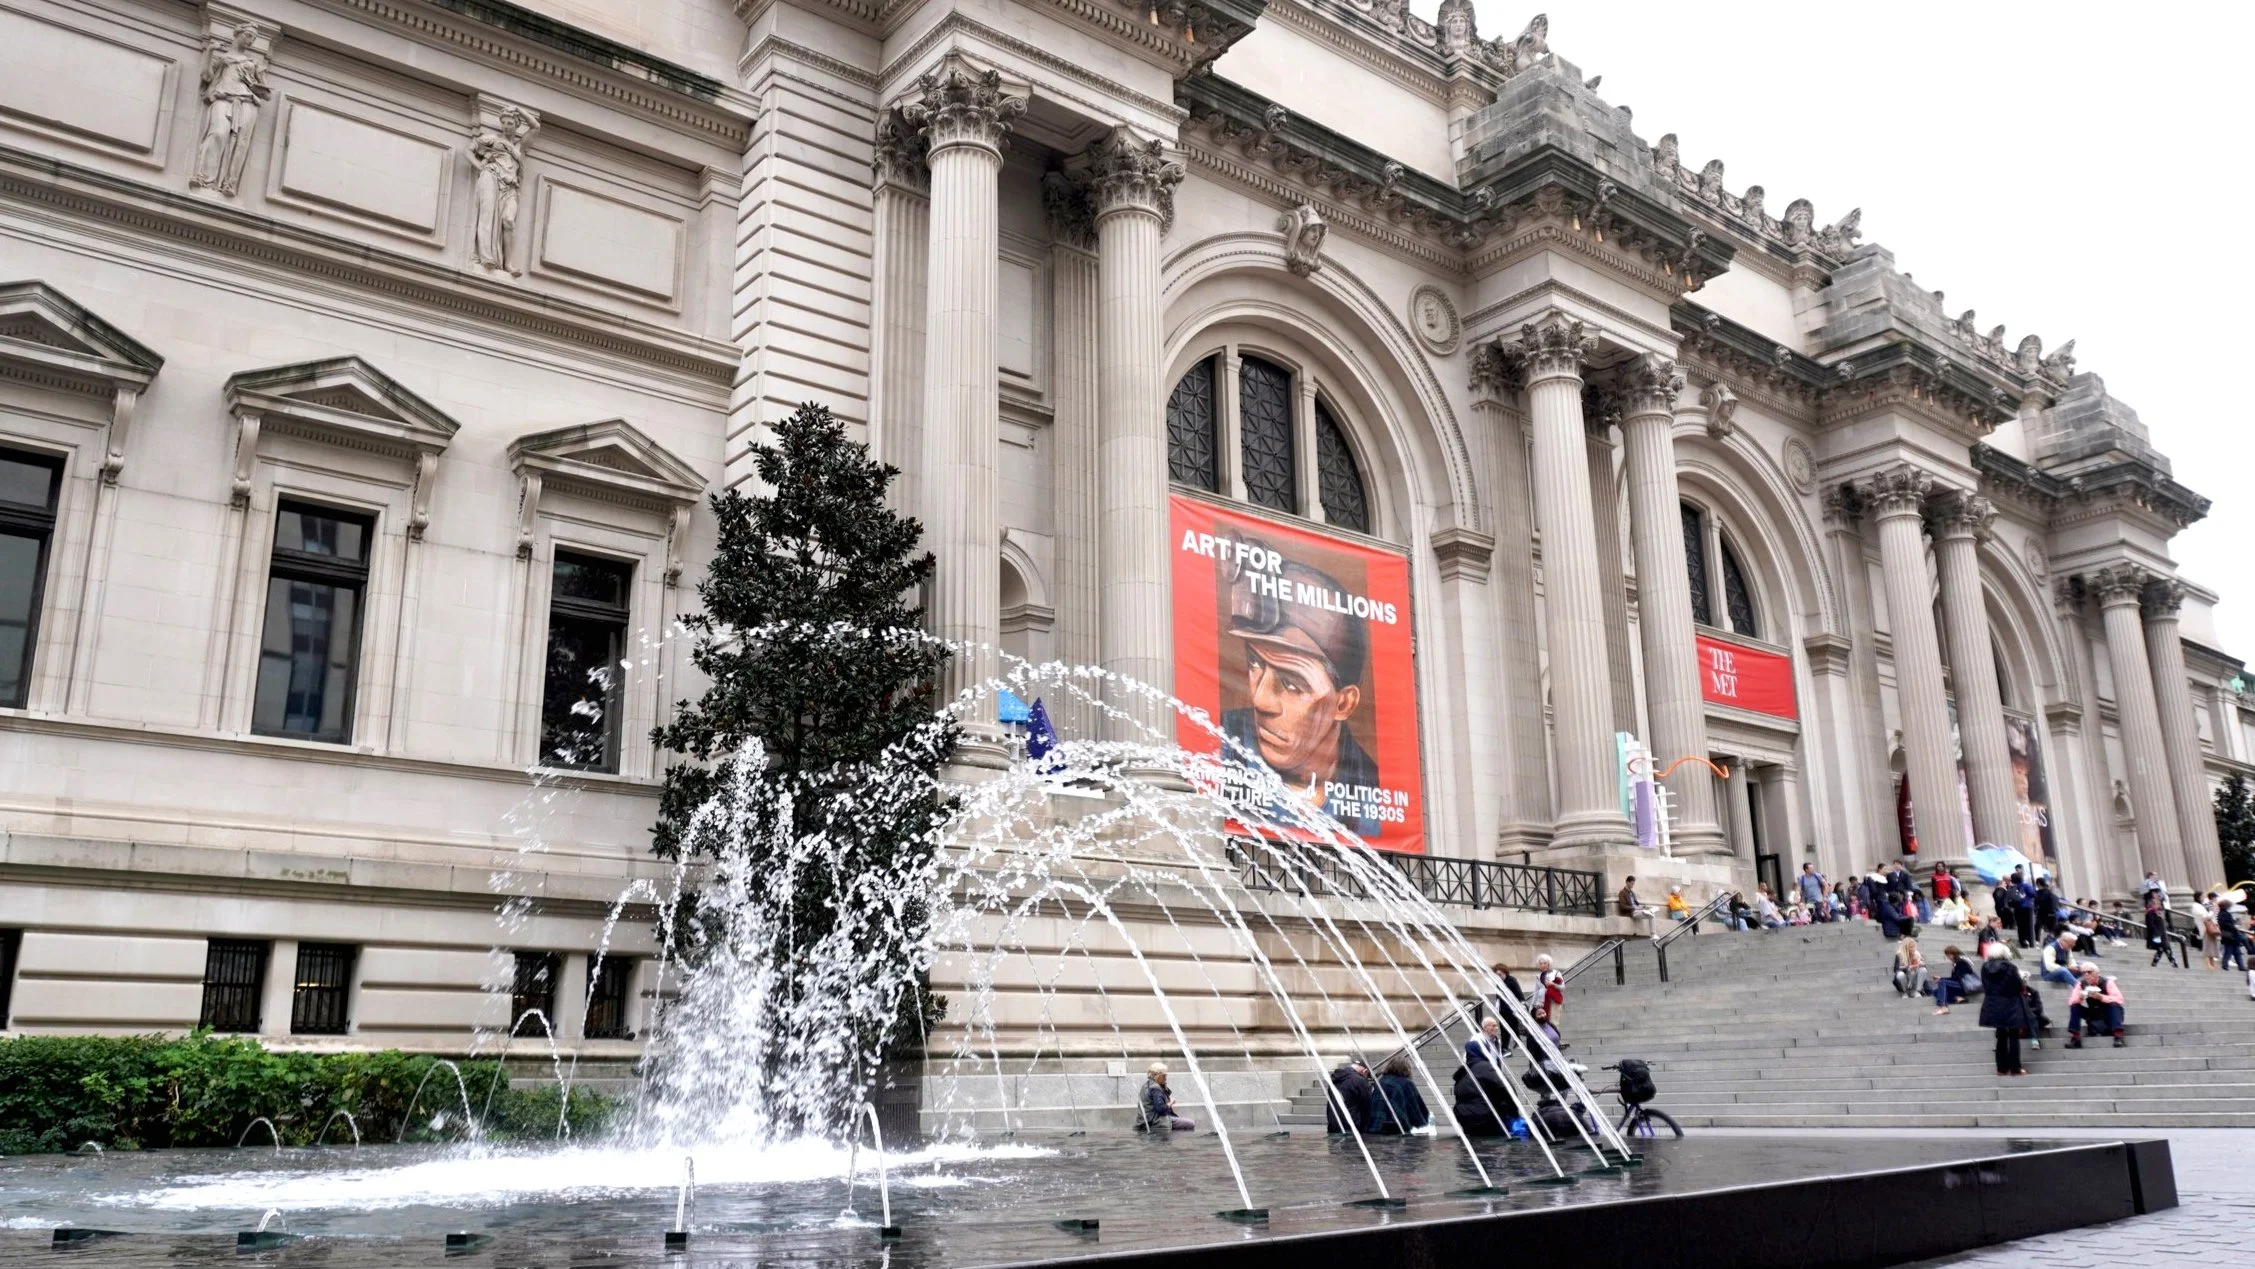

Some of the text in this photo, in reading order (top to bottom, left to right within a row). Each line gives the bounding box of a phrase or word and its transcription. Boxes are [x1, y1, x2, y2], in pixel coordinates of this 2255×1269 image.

[1182, 530, 1282, 574] ART FOR
[1245, 570, 1397, 625] THE MILLIONS
[1707, 647, 1736, 674] THE
[1711, 670, 1738, 697] MET
[1324, 781, 1392, 805] POLITICS
[1394, 790, 1409, 807] IN
[1329, 799, 1405, 823] THE 1930S
[2016, 801, 2048, 827] GAS
